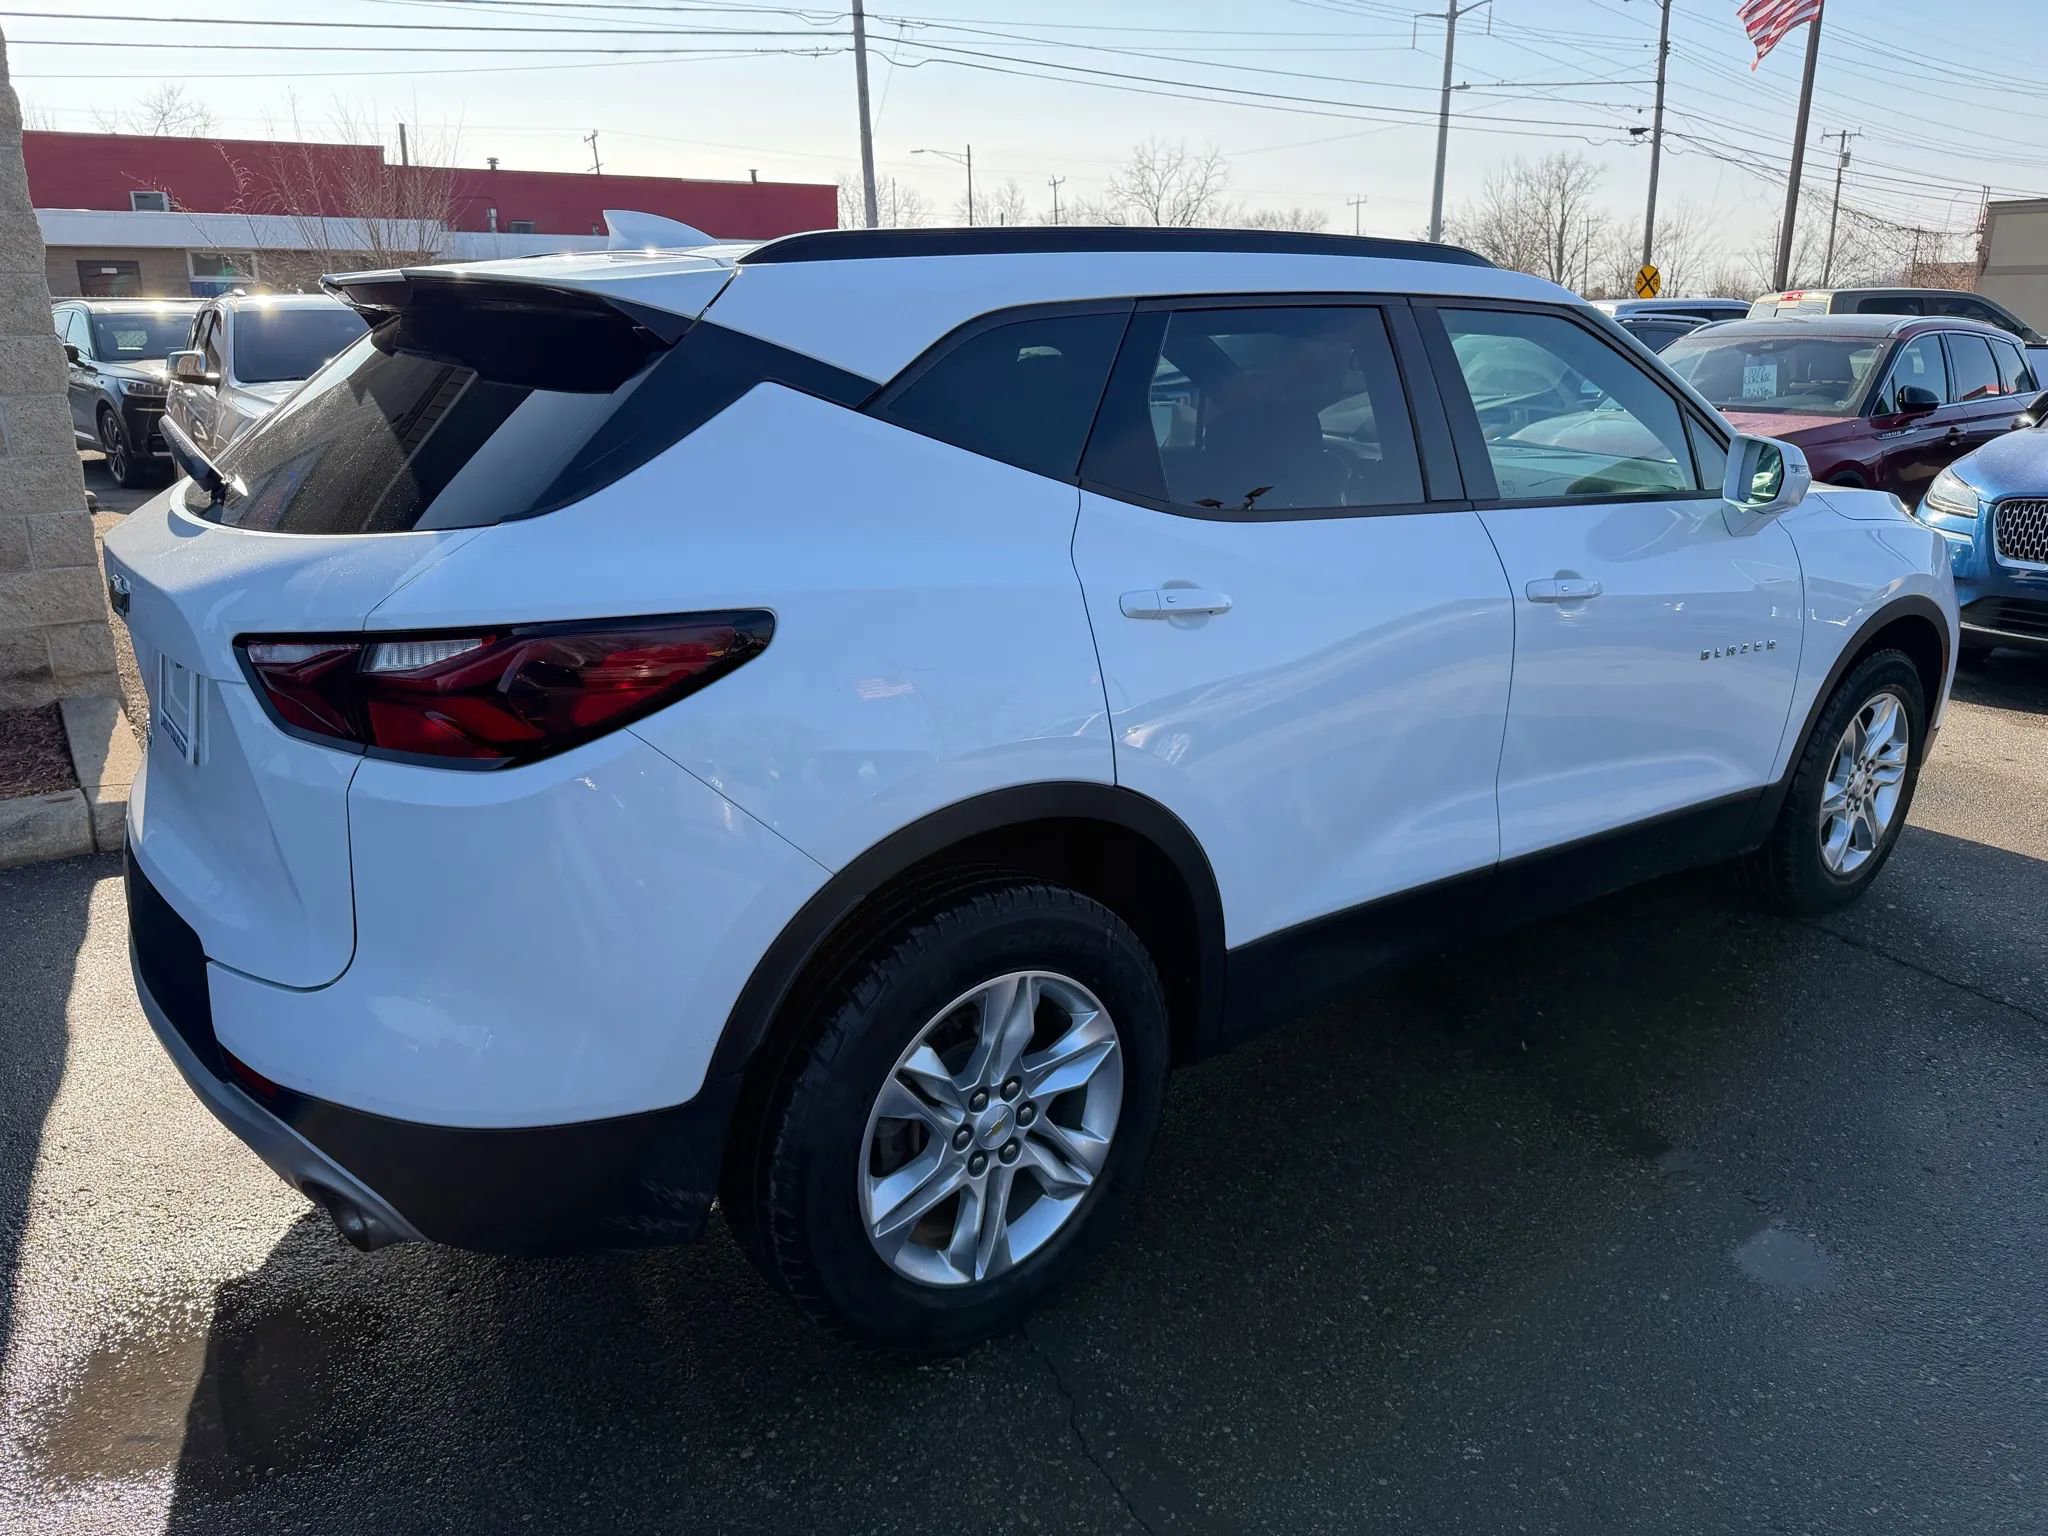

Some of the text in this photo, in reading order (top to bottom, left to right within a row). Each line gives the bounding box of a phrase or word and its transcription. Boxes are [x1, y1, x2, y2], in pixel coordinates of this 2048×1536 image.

[1637, 278, 1659, 288] R R
[1700, 639, 1777, 661] BLAZER
